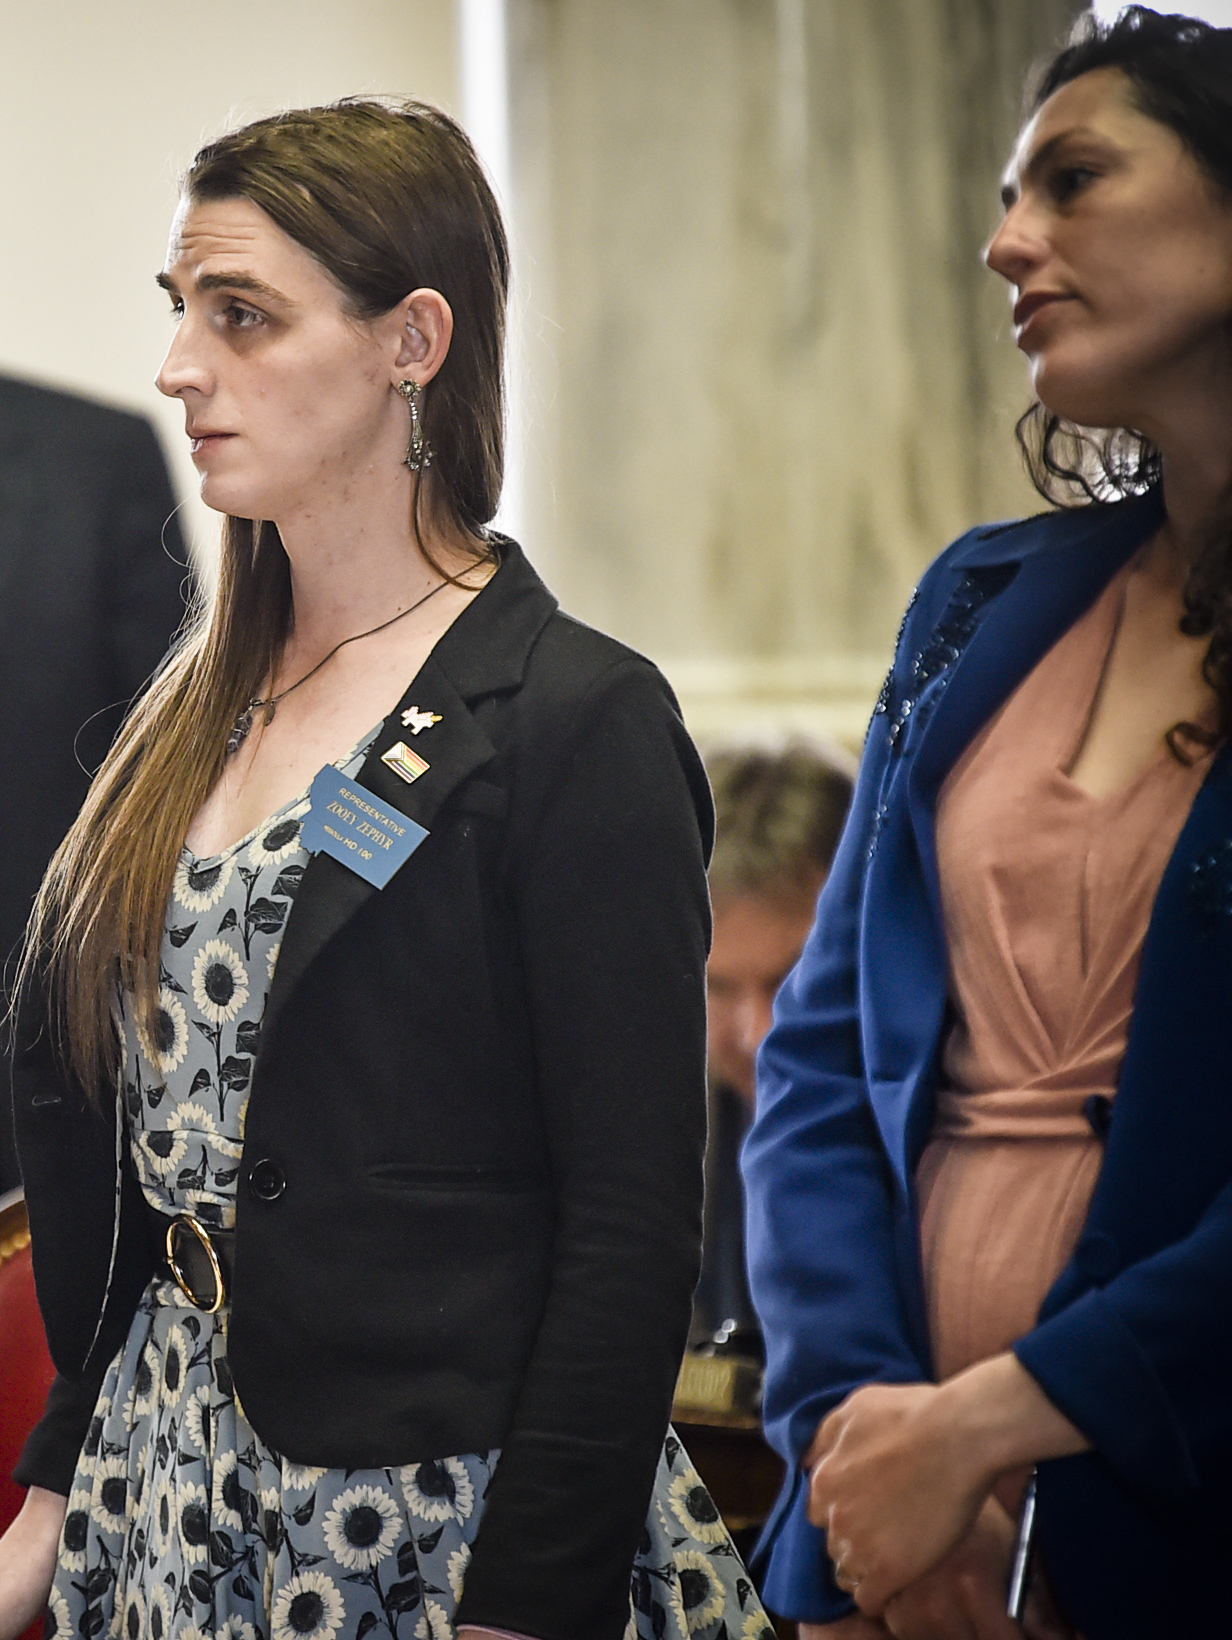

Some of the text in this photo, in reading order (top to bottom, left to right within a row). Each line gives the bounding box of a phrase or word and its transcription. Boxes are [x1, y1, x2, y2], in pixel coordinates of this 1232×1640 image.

[326, 800, 358, 825] ZOOEY
[356, 820, 395, 850] ZEPHYR
[339, 787, 406, 837] REPRESENTATIVE
[343, 837, 373, 860] HD 100
